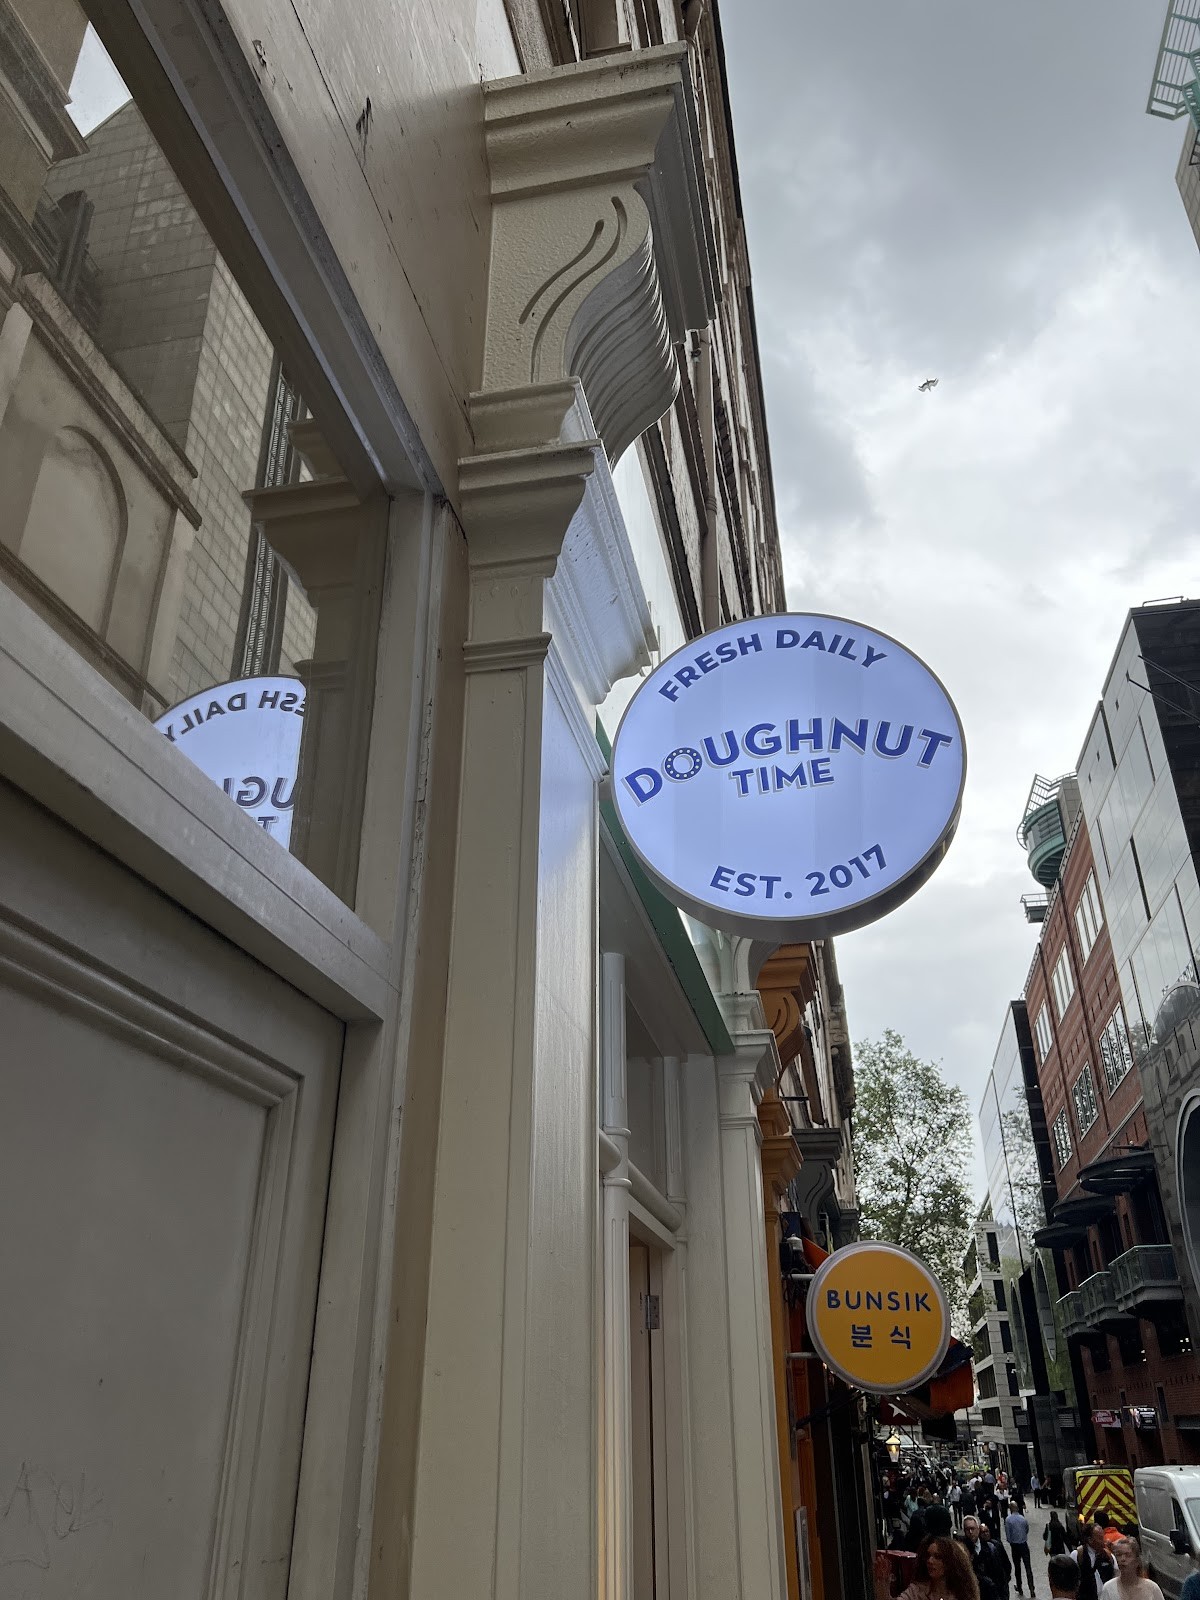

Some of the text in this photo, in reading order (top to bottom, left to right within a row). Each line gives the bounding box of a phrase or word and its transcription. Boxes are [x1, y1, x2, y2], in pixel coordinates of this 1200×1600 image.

[658, 629, 888, 703] FRESH DAILY
[620, 716, 954, 806] DOUGHNUT
[729, 756, 835, 798] TIME
[709, 843, 888, 900] EST. 2017
[826, 1289, 932, 1312] BUNSIK
